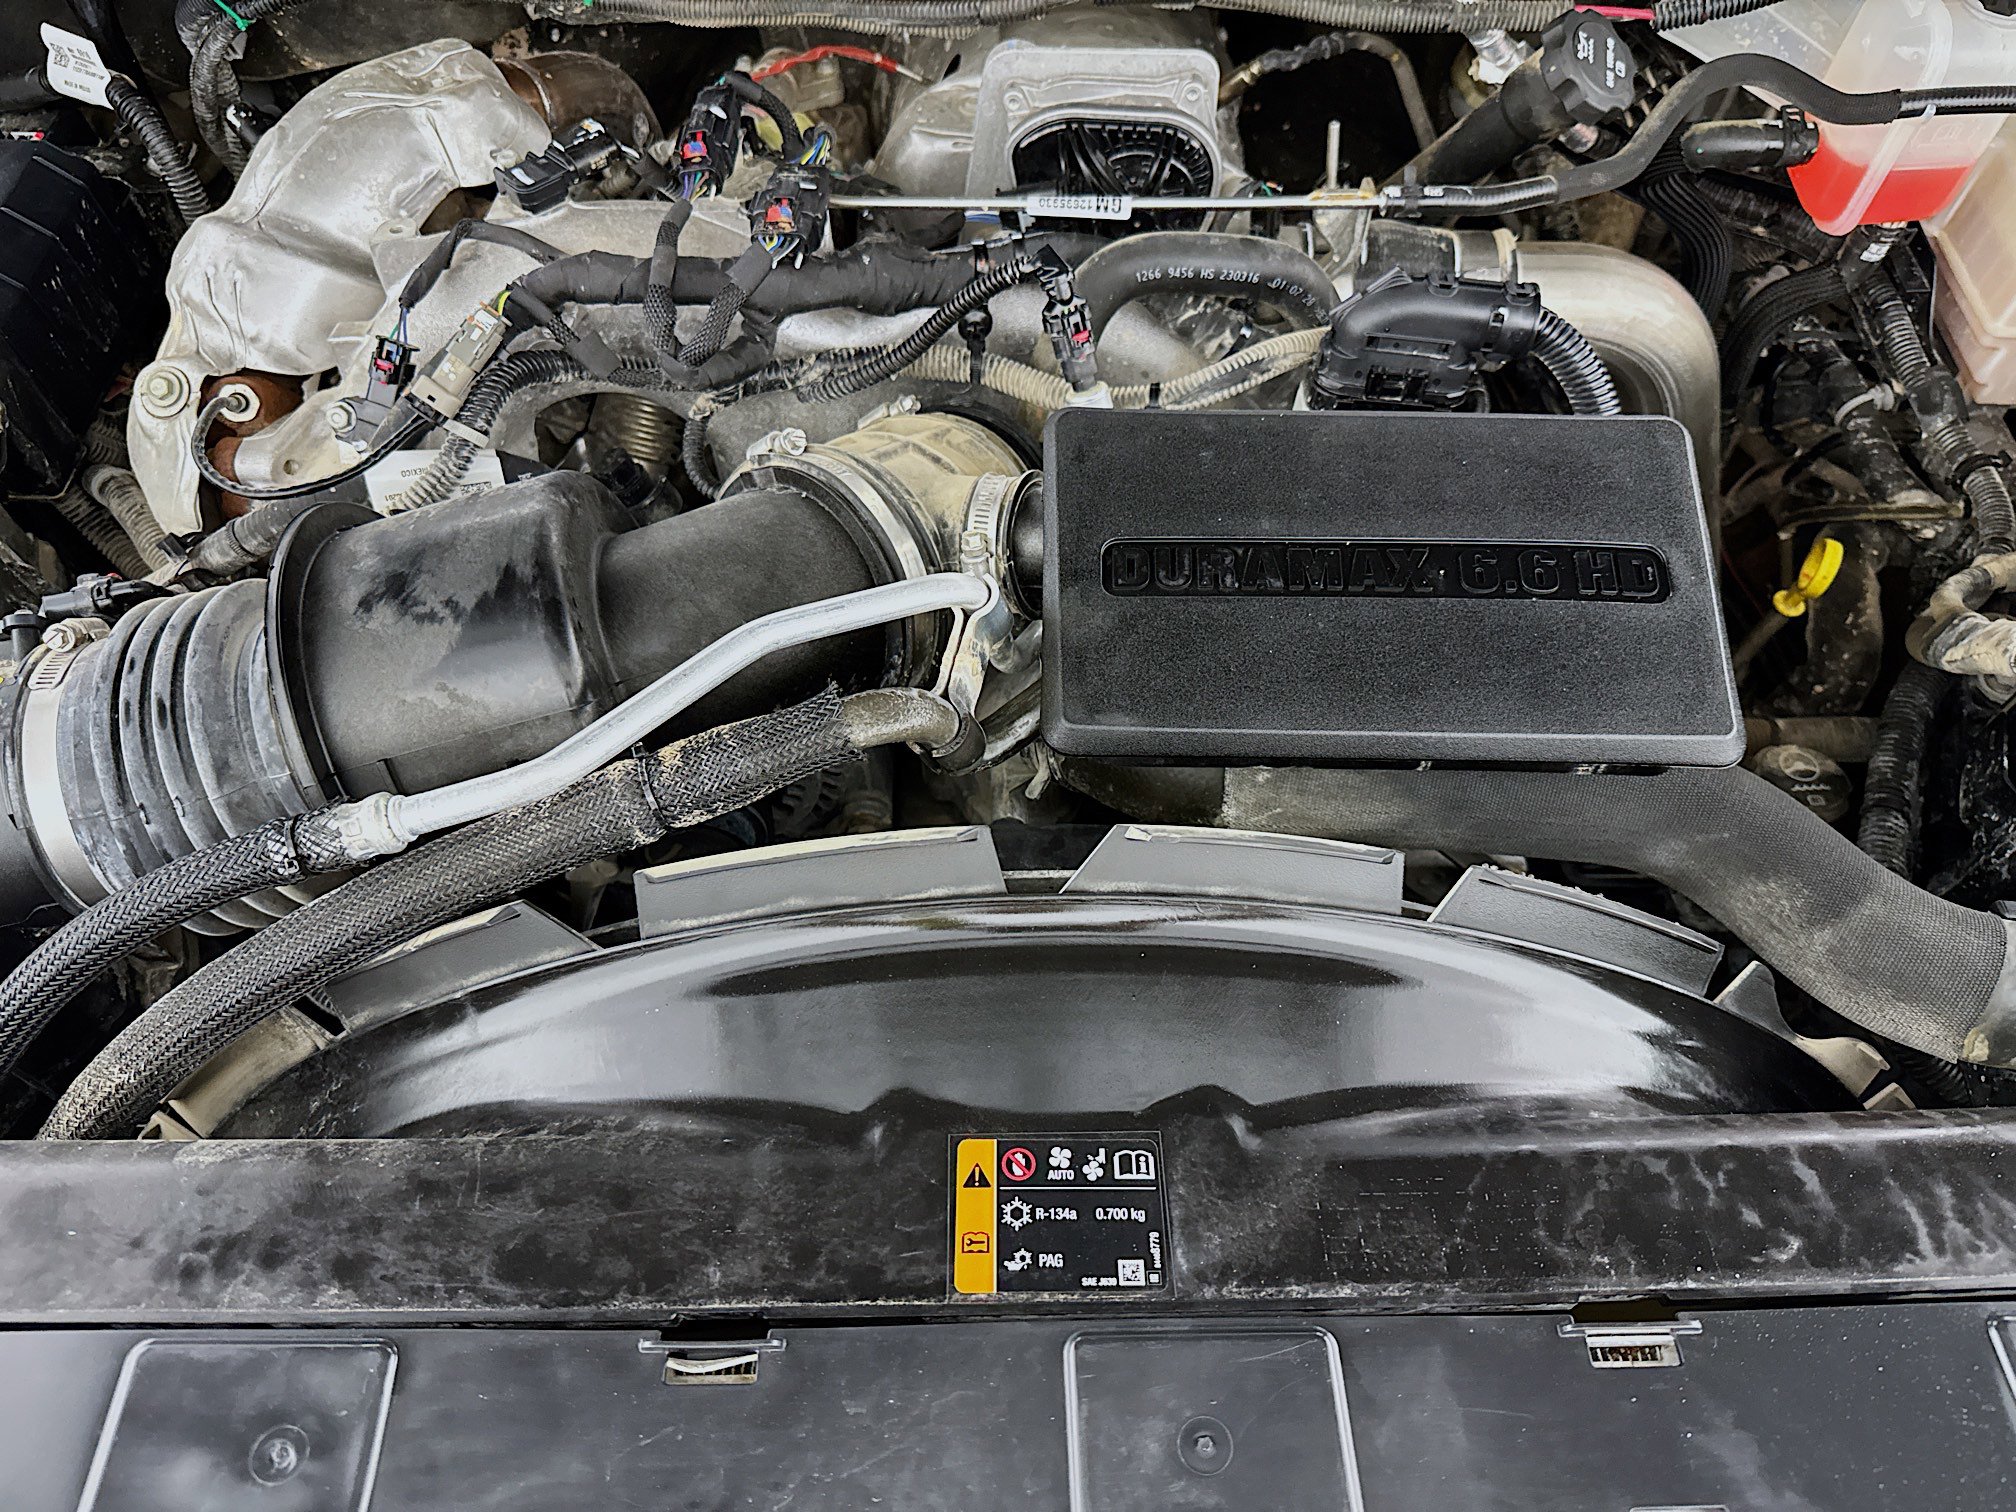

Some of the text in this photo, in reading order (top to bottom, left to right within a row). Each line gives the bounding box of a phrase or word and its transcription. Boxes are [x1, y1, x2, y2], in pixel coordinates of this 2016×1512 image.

[1096, 198, 1122, 214] GM
[1136, 268, 1162, 283] 1266
[1168, 267, 1194, 279] 9456
[1200, 268, 1214, 280] HS
[1220, 270, 1260, 284] 230316
[1111, 547, 1661, 598] DURAMAX 6.6 HD
[1047, 1170, 1075, 1180] AUTO
[1035, 1207, 1146, 1222] R-134a 0.700 kg
[1038, 1253, 1063, 1268] PAG
